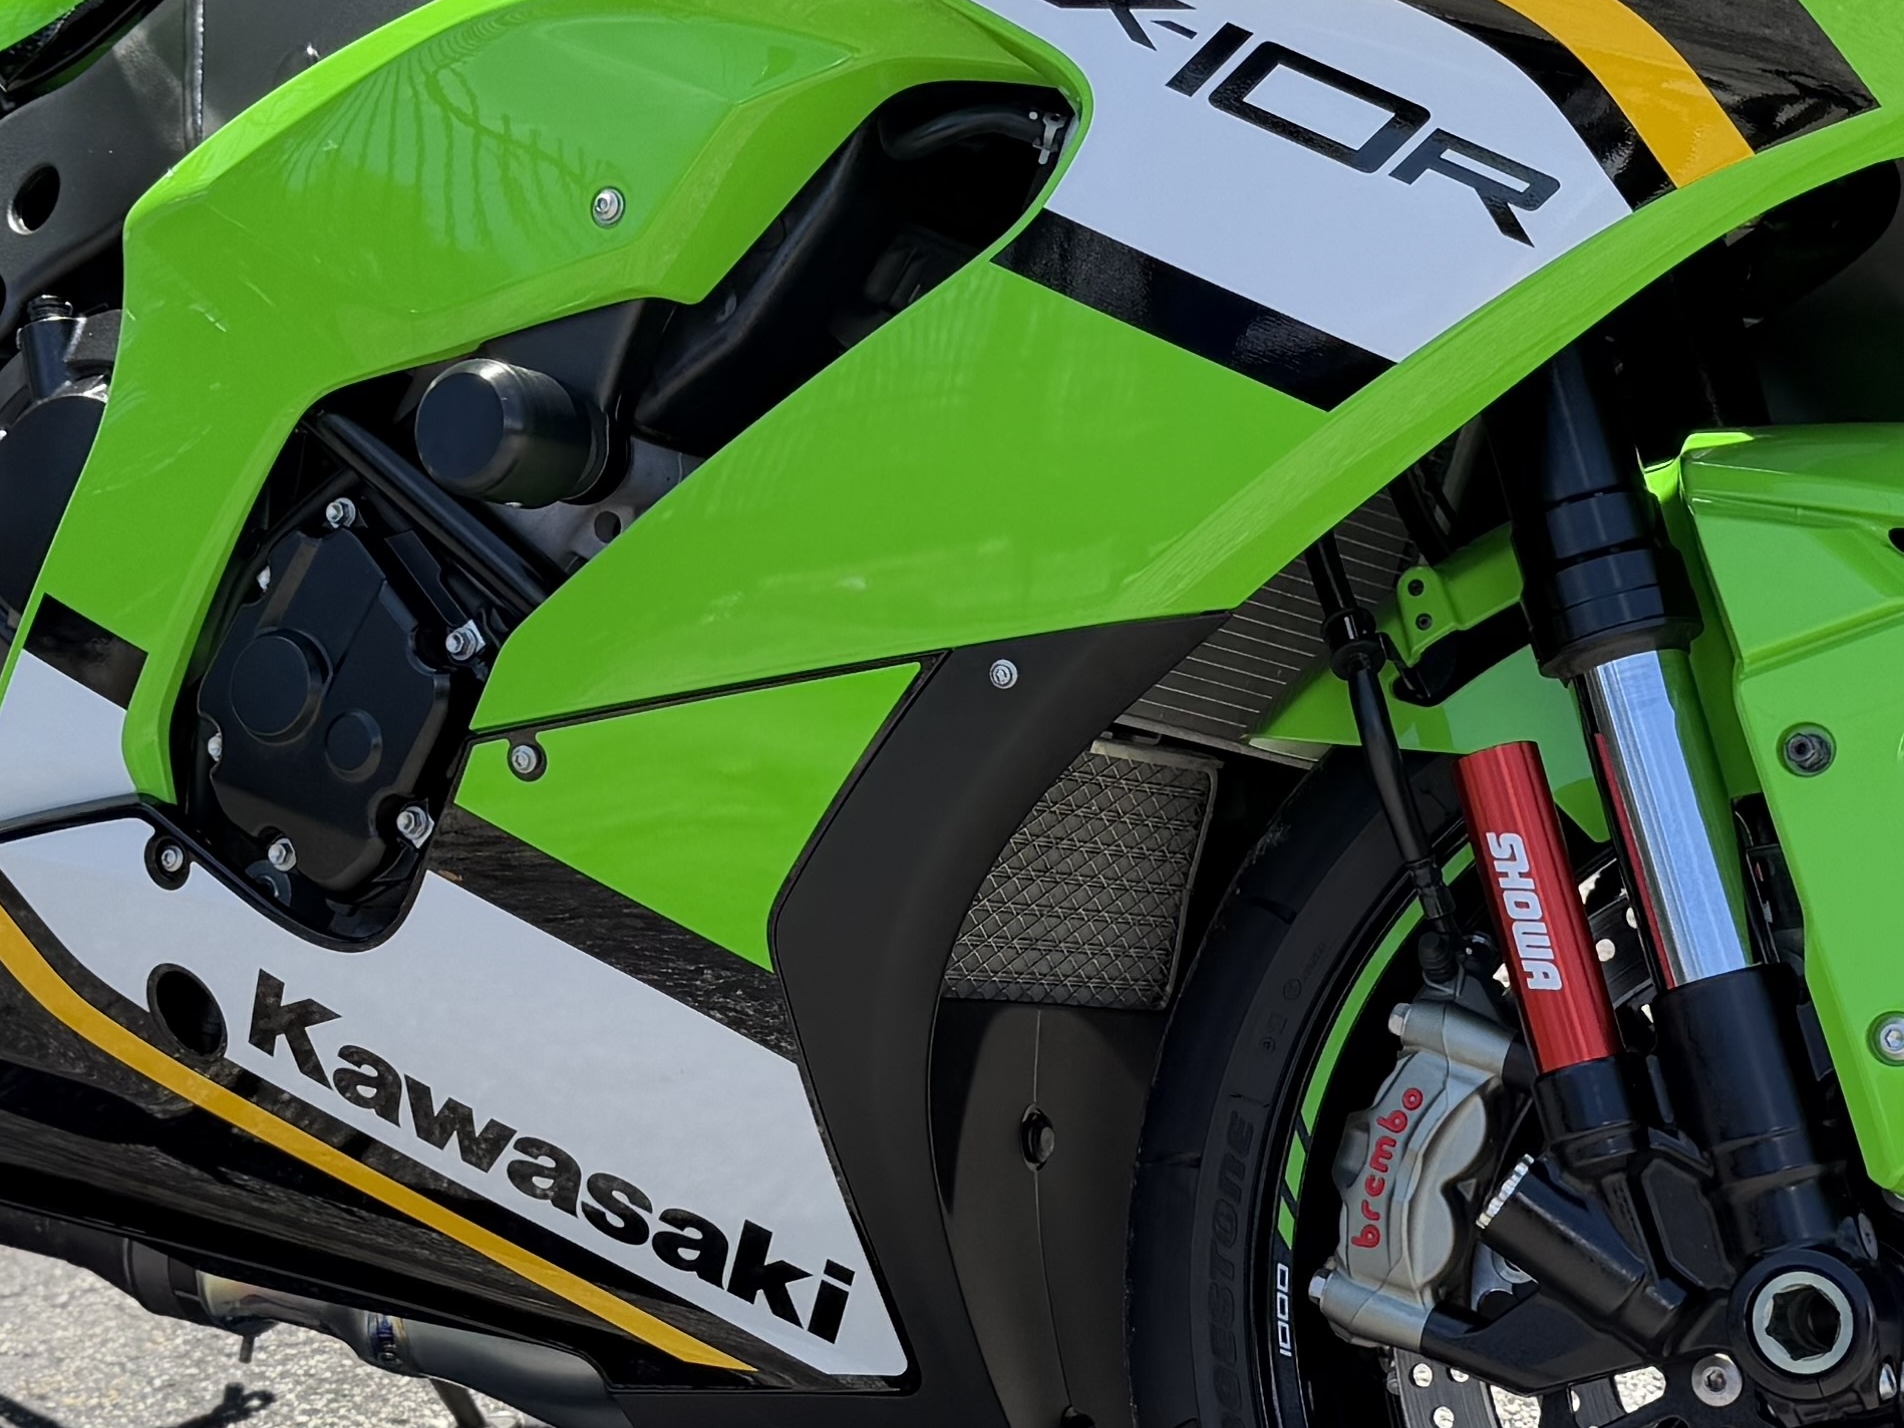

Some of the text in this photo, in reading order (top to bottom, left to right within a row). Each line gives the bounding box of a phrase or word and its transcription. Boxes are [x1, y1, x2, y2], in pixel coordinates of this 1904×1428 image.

[1486, 831, 1562, 992] SHOWA
[248, 967, 856, 1344] Kawasaki
[1350, 1087, 1425, 1249] brembo
[1277, 1262, 1291, 1358] 1000
